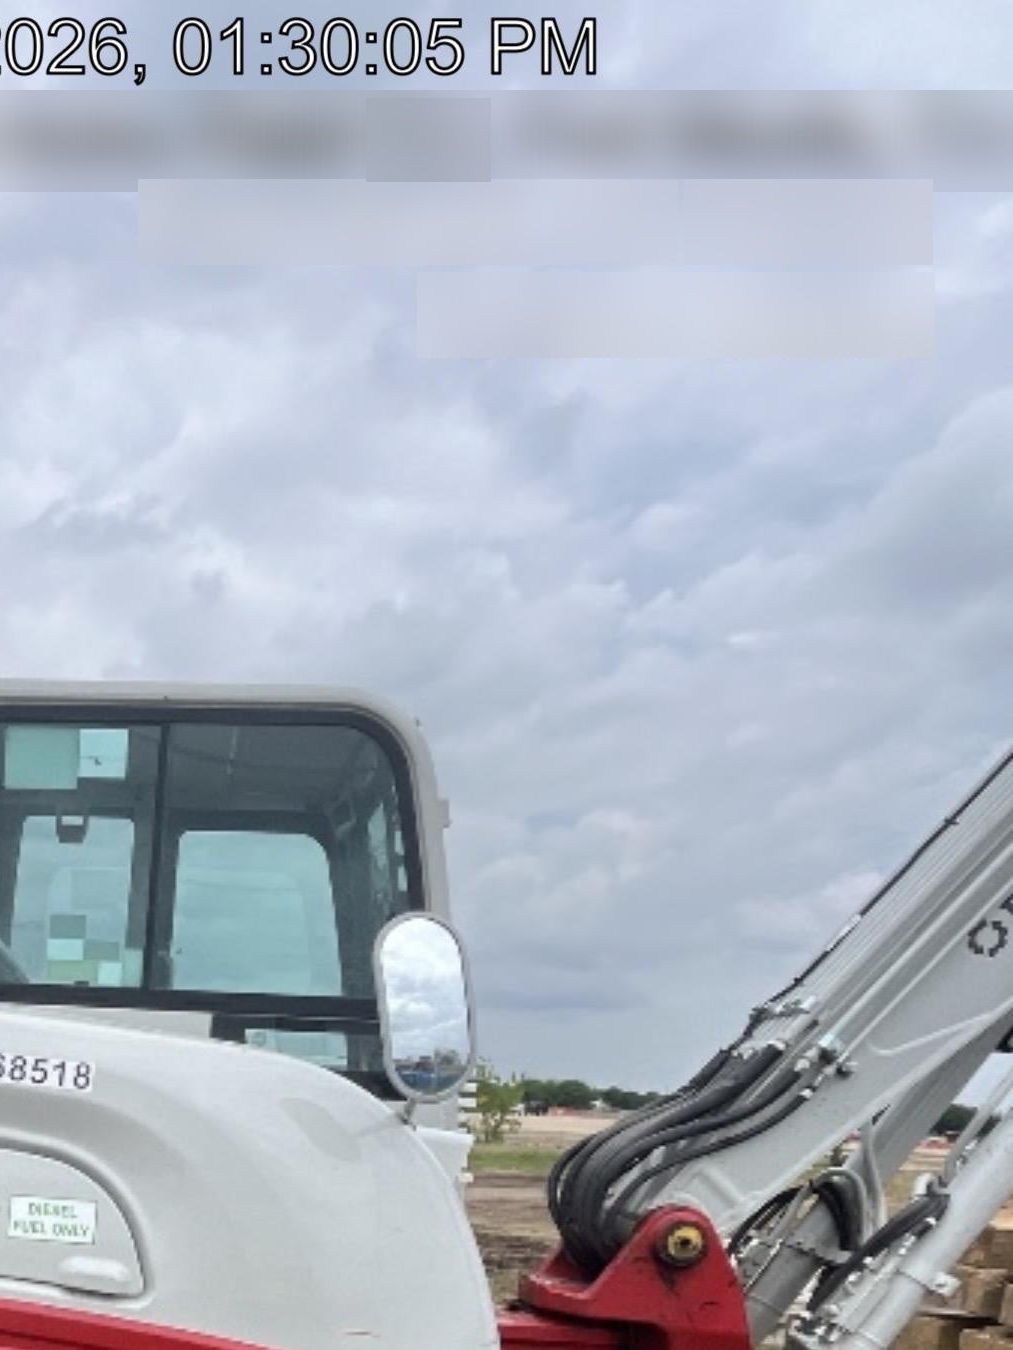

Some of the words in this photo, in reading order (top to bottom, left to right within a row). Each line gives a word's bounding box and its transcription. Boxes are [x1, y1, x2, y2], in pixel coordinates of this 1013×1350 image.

[28, 1202, 78, 1219] DIESEL
[13, 1220, 45, 1234] FUEL
[52, 1223, 90, 1237] ONLY
